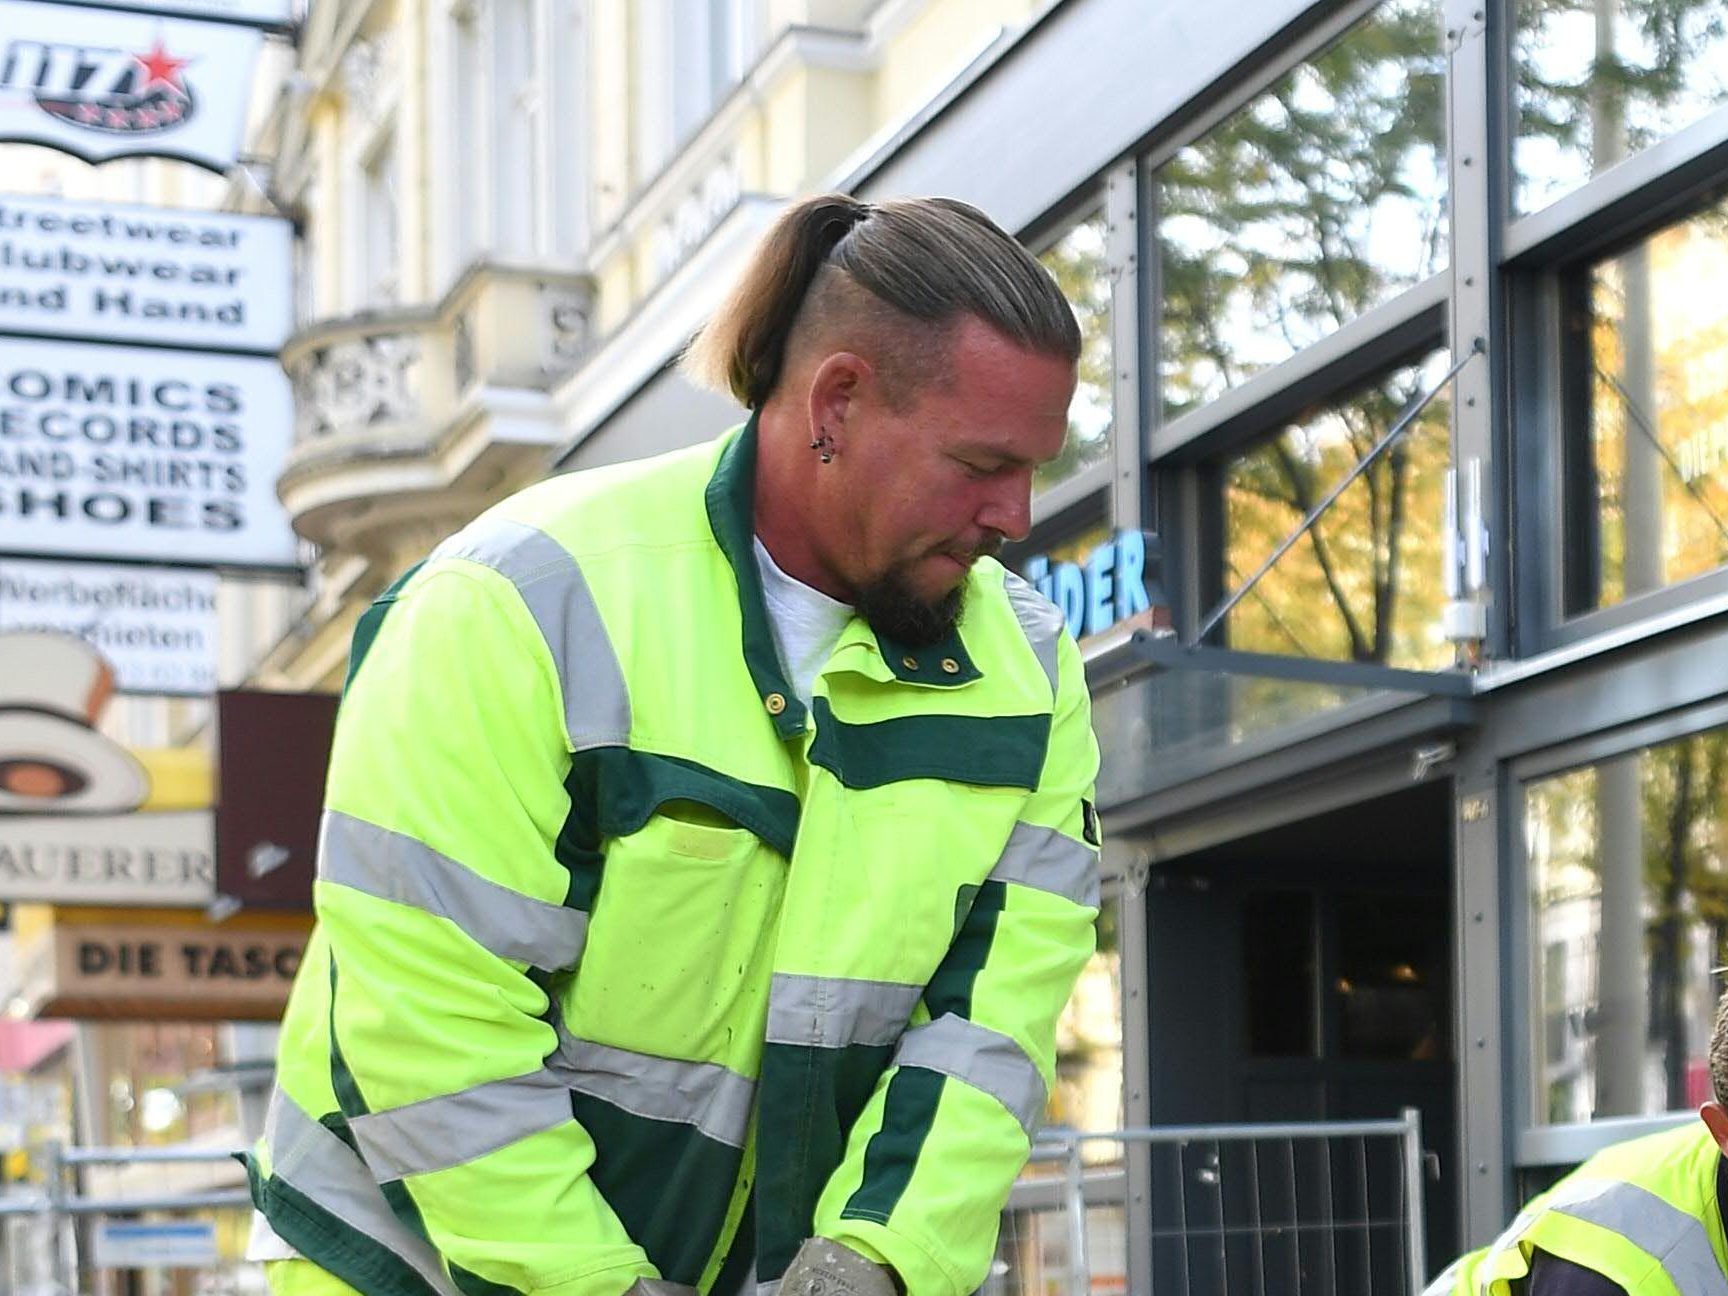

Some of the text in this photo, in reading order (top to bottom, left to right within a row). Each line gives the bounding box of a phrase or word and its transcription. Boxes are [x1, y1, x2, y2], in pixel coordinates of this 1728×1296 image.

[94, 288, 244, 325] Hand
[10, 370, 241, 413] OMICS
[93, 454, 246, 493] SHIRTS
[0, 489, 243, 530] HOES
[79, 941, 160, 977] DIE
